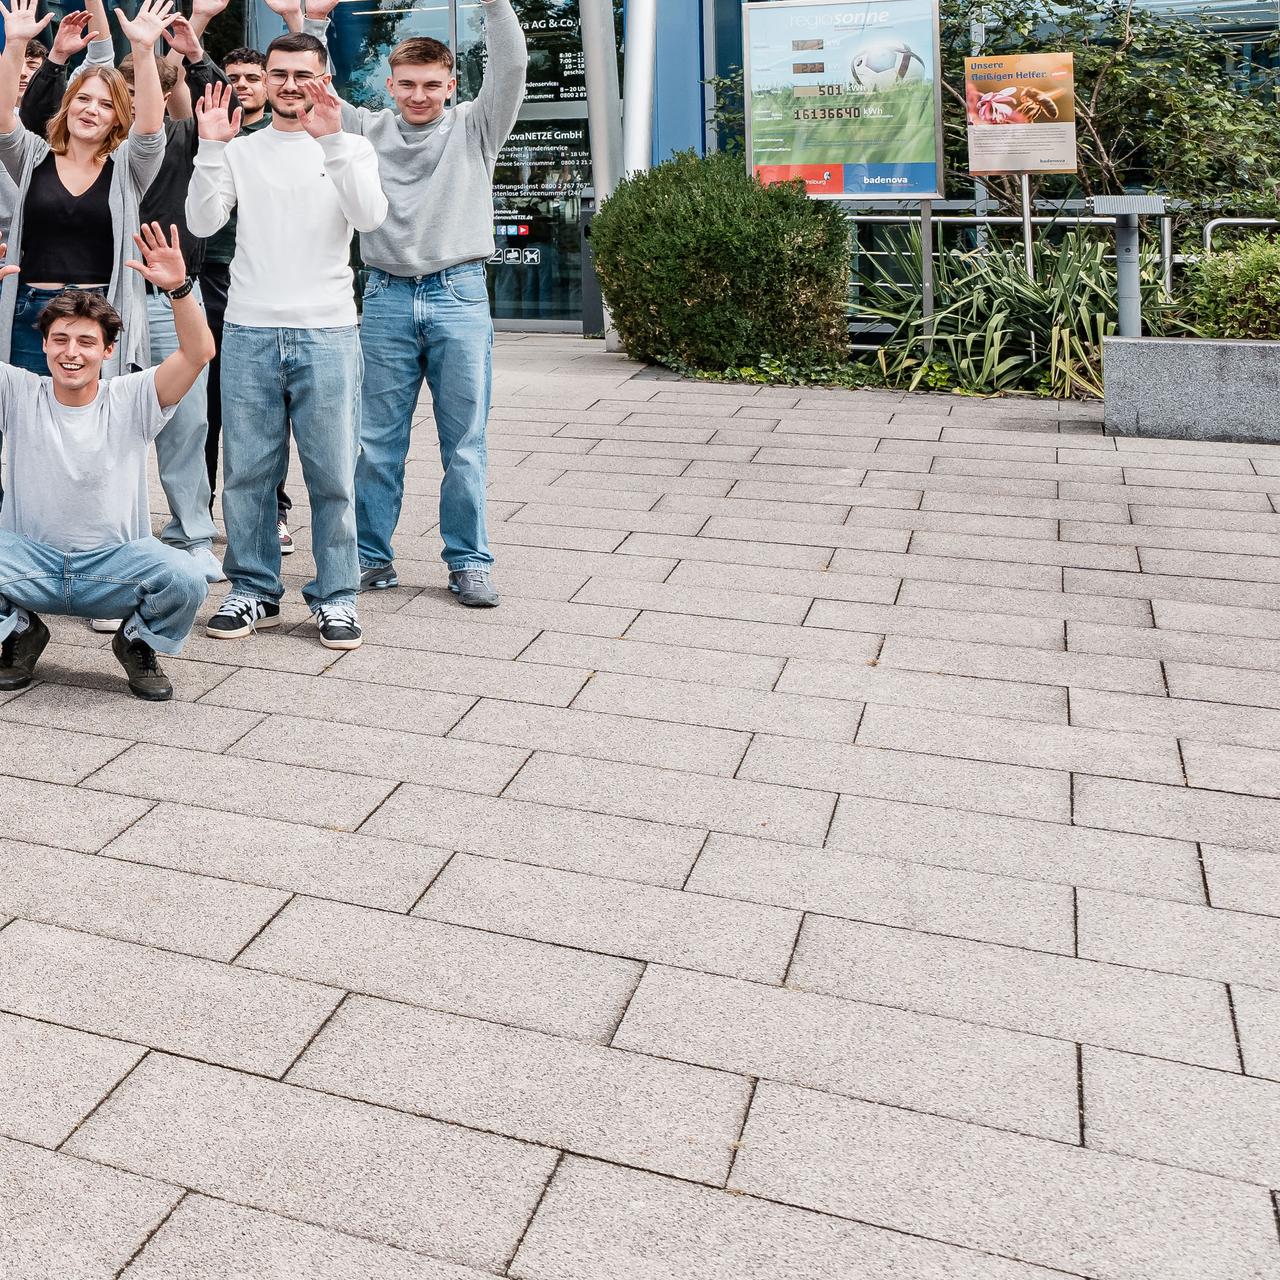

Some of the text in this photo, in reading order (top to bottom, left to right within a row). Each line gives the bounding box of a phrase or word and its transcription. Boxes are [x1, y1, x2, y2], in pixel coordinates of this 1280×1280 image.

[531, 20, 546, 29] AG
[549, 19, 558, 28] &
[560, 19, 576, 27] Co.
[790, 10, 889, 29] regiosonne
[970, 61, 1004, 71] Unsere
[563, 69, 585, 77] geschlo
[818, 85, 843, 96] 501
[794, 107, 861, 120] 16136640
[863, 106, 883, 116] kWh
[554, 130, 583, 140] GmbH
[524, 144, 568, 152] Kundenservice
[863, 175, 908, 184] badenova
